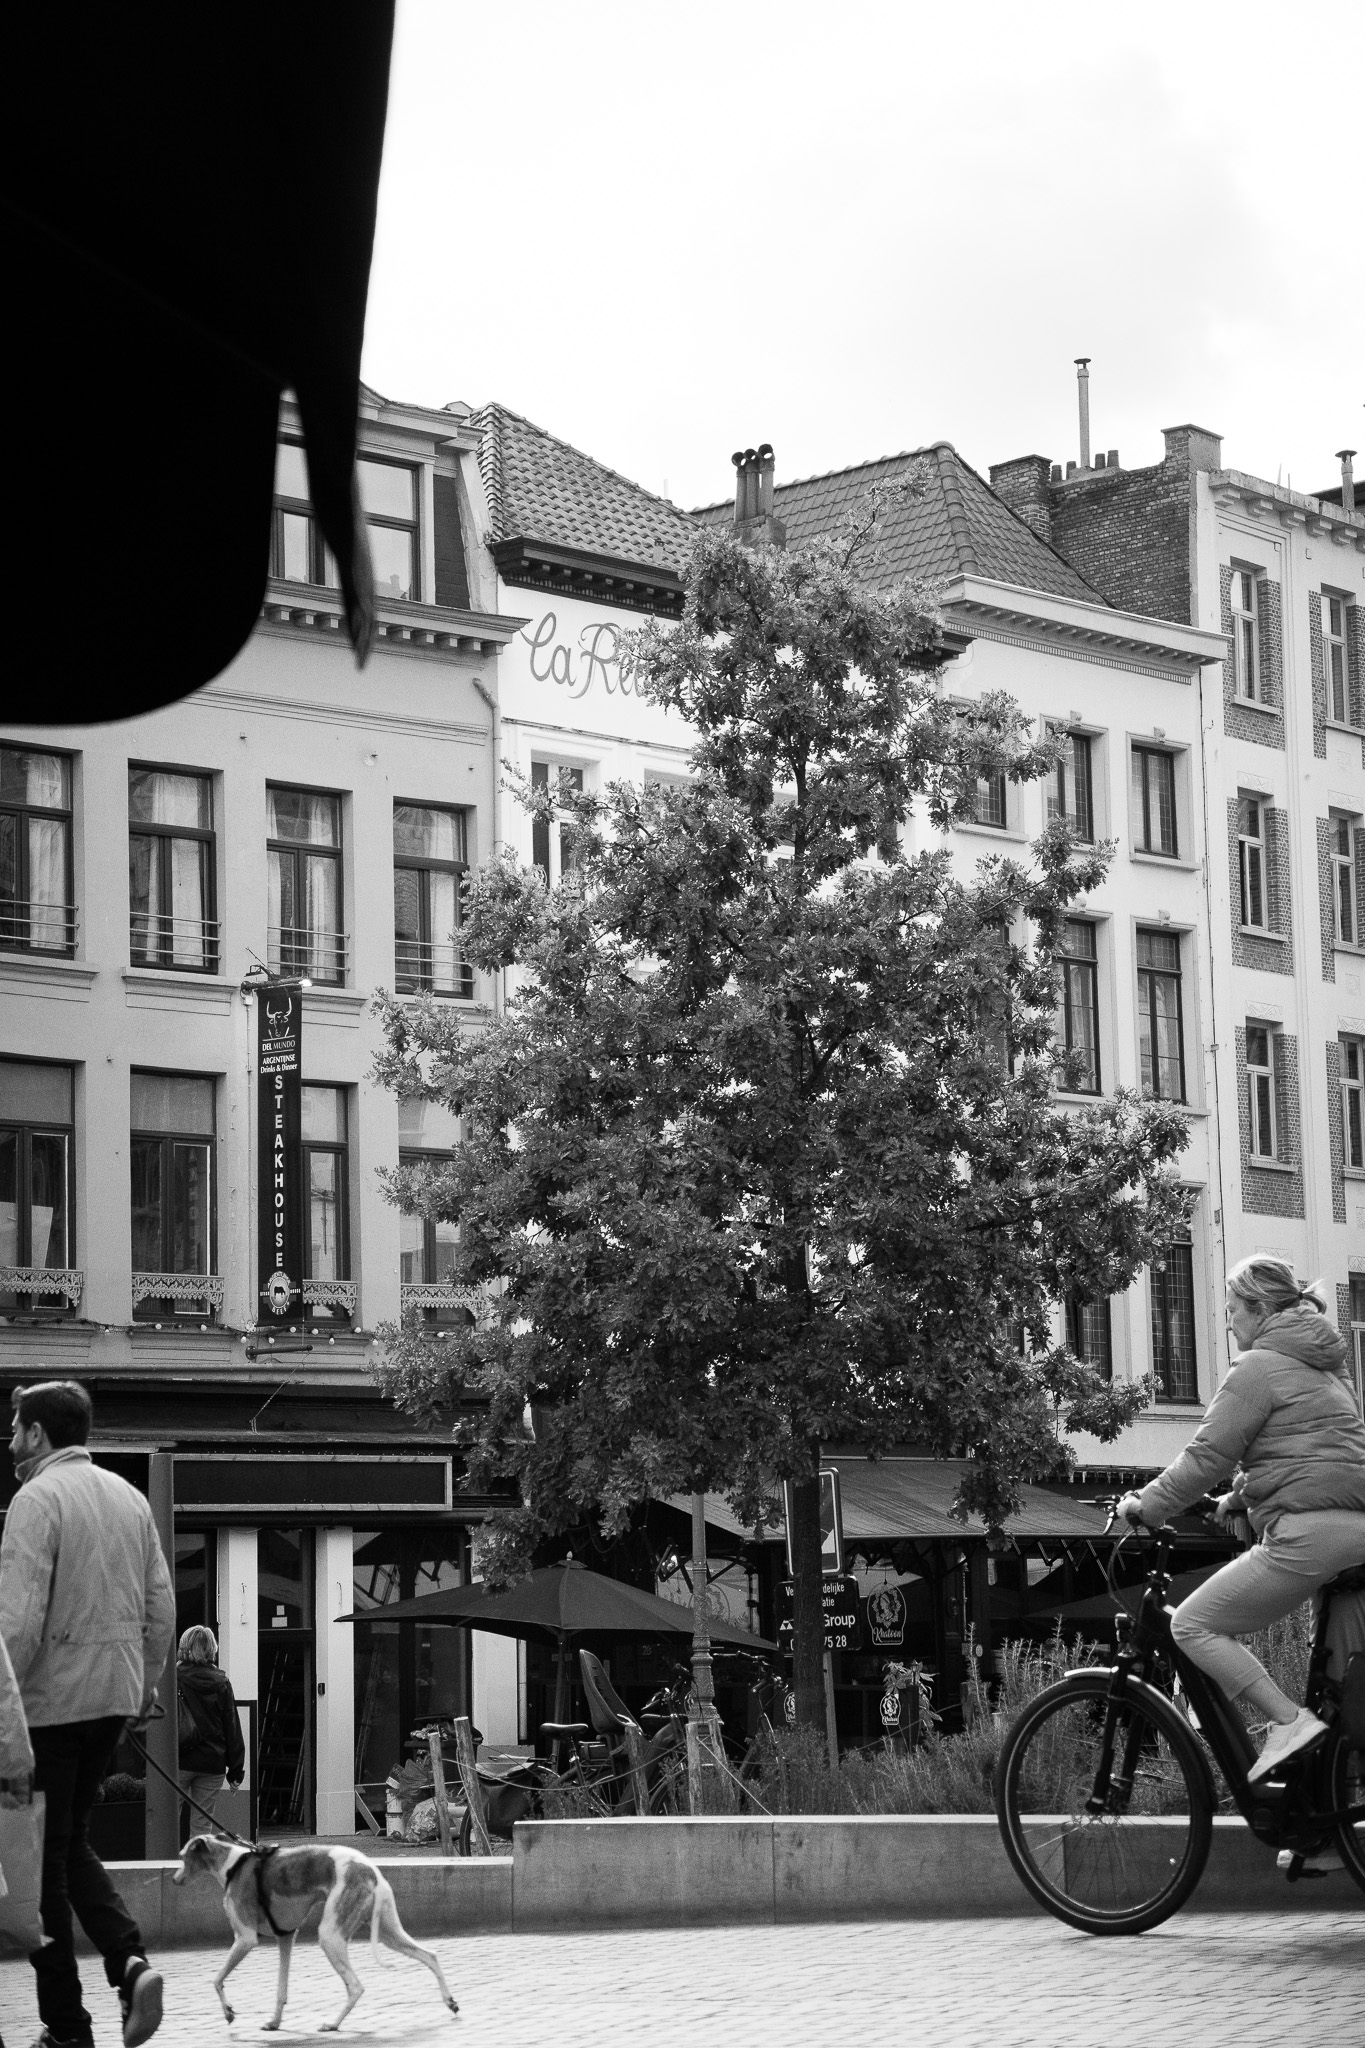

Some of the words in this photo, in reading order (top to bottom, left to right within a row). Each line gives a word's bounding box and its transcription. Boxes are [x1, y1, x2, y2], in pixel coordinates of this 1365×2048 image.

[519, 612, 577, 686] La
[262, 1043, 272, 1051] DEL
[273, 1040, 295, 1049] MUNDO
[260, 1065, 275, 1073] Drinks
[282, 1063, 297, 1071] Dinner
[274, 1075, 284, 1267] STEAKHOUSE
[835, 1634, 847, 1648] 28
